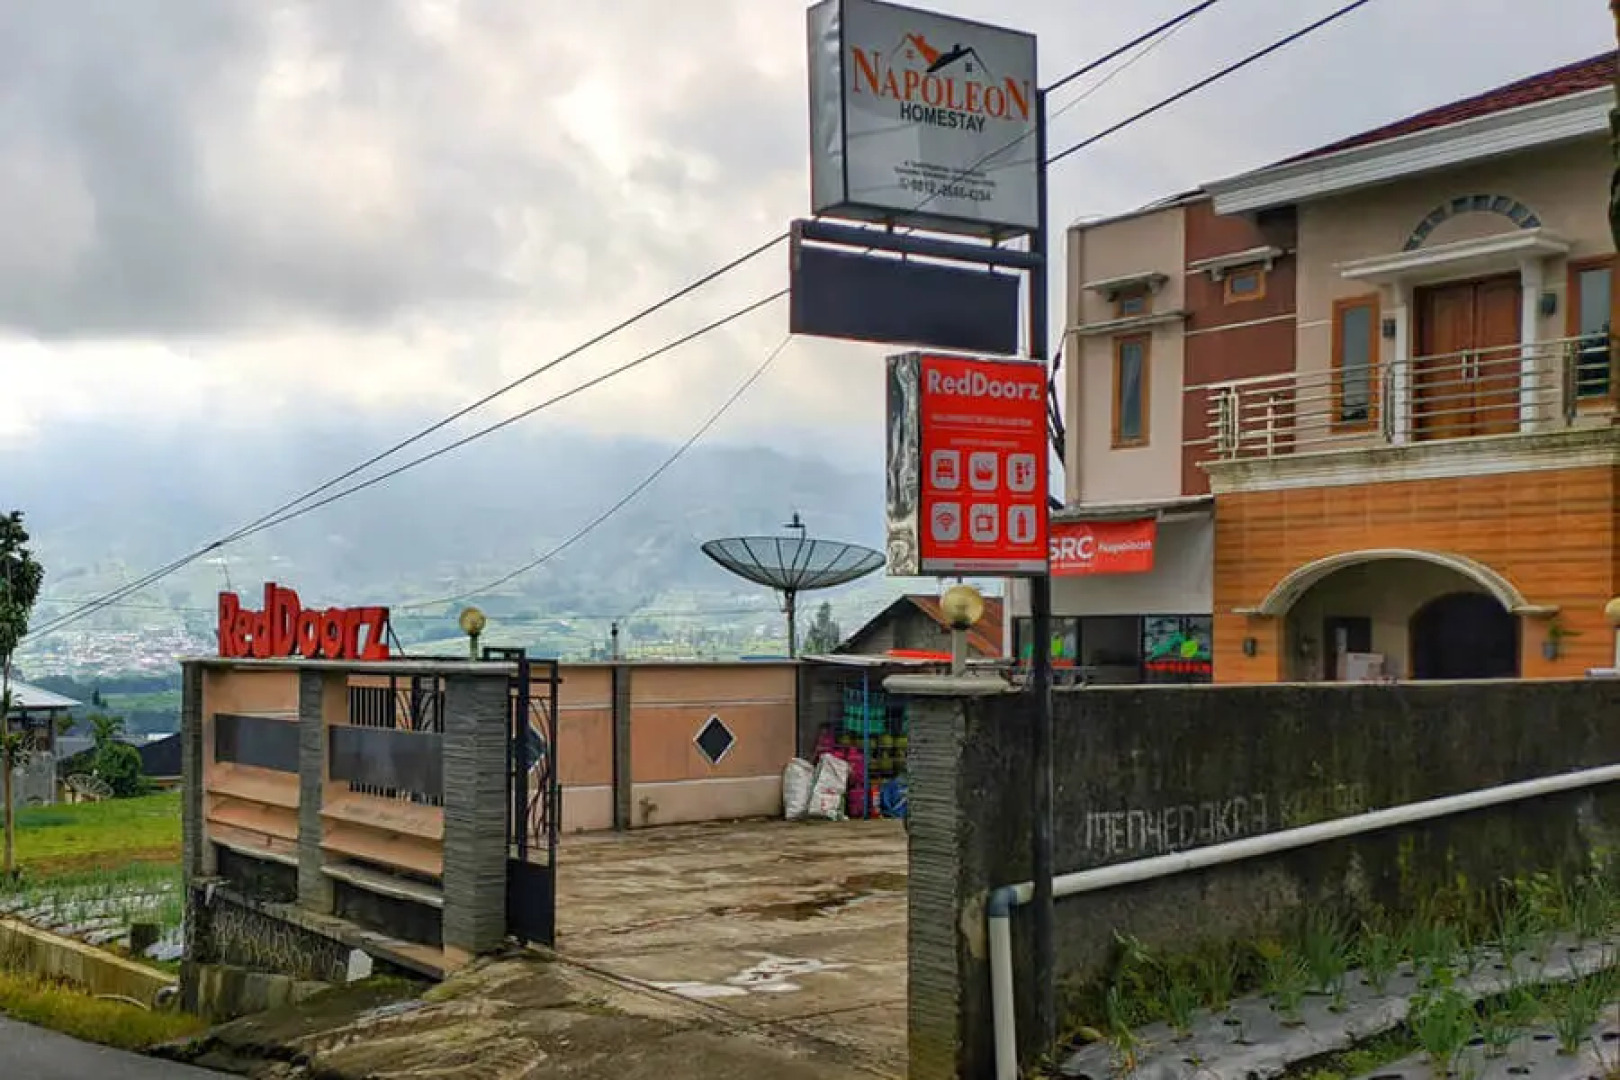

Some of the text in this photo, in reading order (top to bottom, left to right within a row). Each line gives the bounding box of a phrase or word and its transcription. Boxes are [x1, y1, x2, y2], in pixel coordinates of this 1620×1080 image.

[900, 101, 986, 133] HOMESTAY
[927, 368, 1041, 400] RedDoorz
[1049, 535, 1094, 561] SRC
[218, 582, 390, 659] RedDoorz
